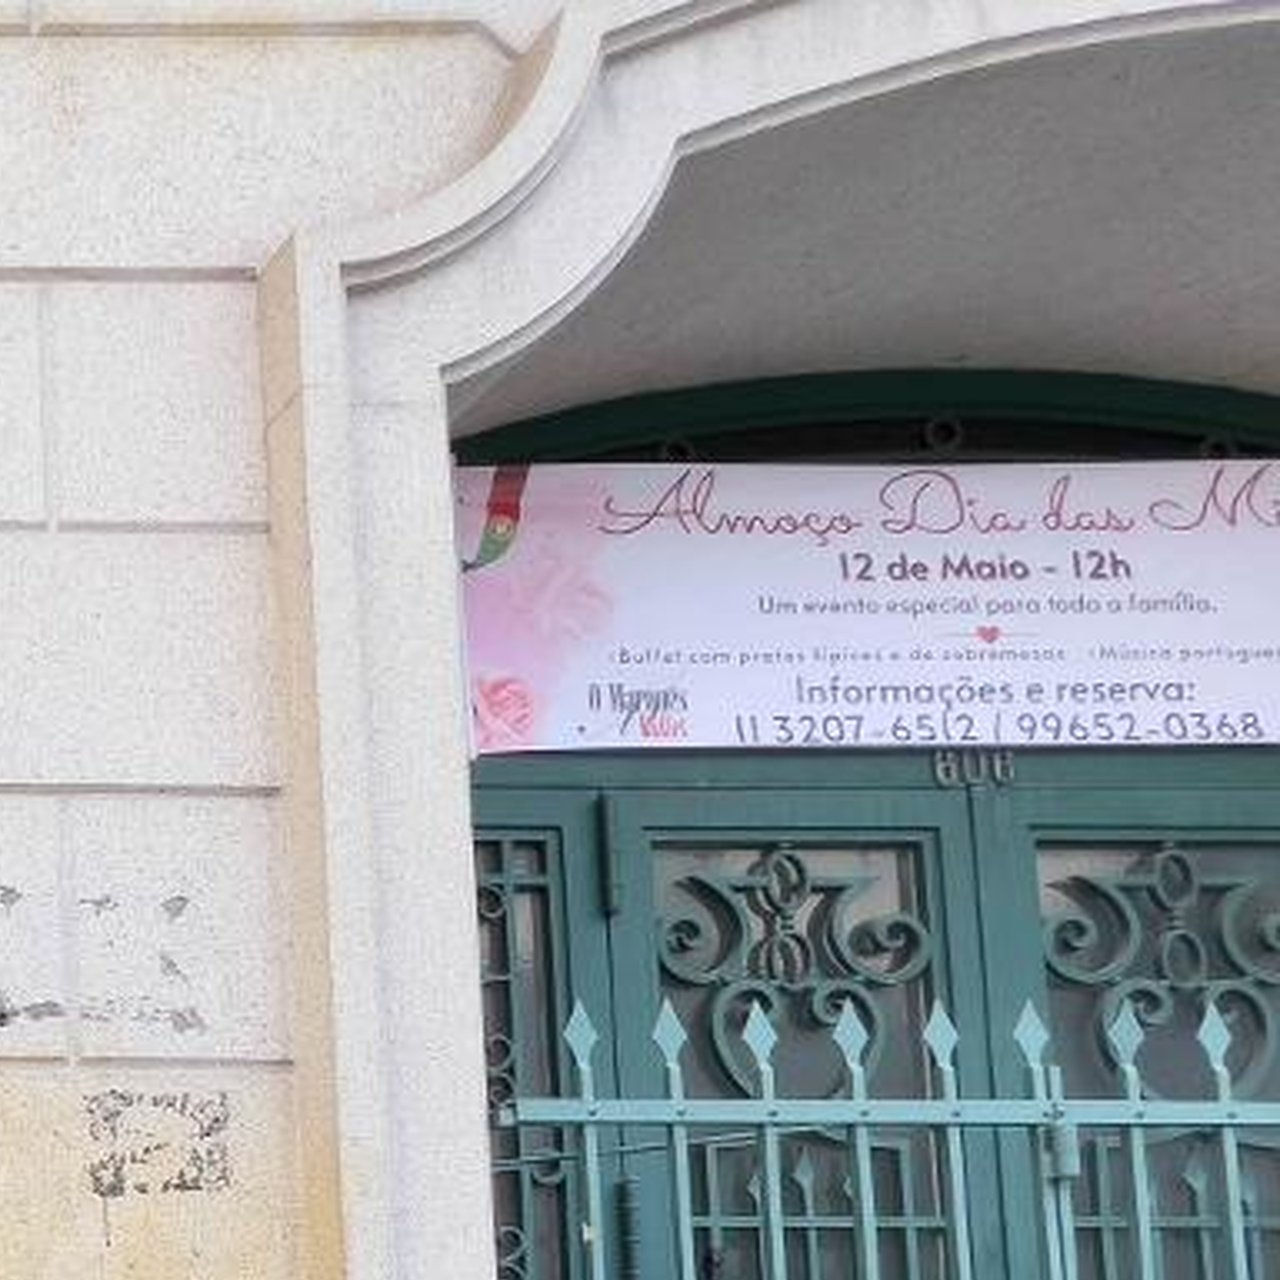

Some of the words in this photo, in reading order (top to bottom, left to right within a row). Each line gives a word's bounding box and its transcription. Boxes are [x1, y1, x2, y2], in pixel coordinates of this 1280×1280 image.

[598, 468, 863, 546] Almoço
[879, 469, 1028, 534] Dia
[1042, 474, 1137, 532] das
[1148, 463, 1280, 531] M
[840, 553, 875, 582] 12
[887, 553, 930, 581] de
[941, 552, 1030, 581] Maio
[1073, 550, 1133, 580] 12h
[758, 596, 798, 615] Um
[803, 598, 878, 614] evento
[886, 596, 979, 619] especial
[986, 599, 1041, 618] para
[1107, 601, 1122, 615] a
[1128, 590, 1218, 615] família.
[690, 651, 731, 664] com
[910, 649, 934, 662] de
[795, 675, 1015, 710] Informações
[1026, 683, 1044, 702] e
[1056, 682, 1196, 702] reserva:
[1016, 711, 1265, 742] 99652-0368
